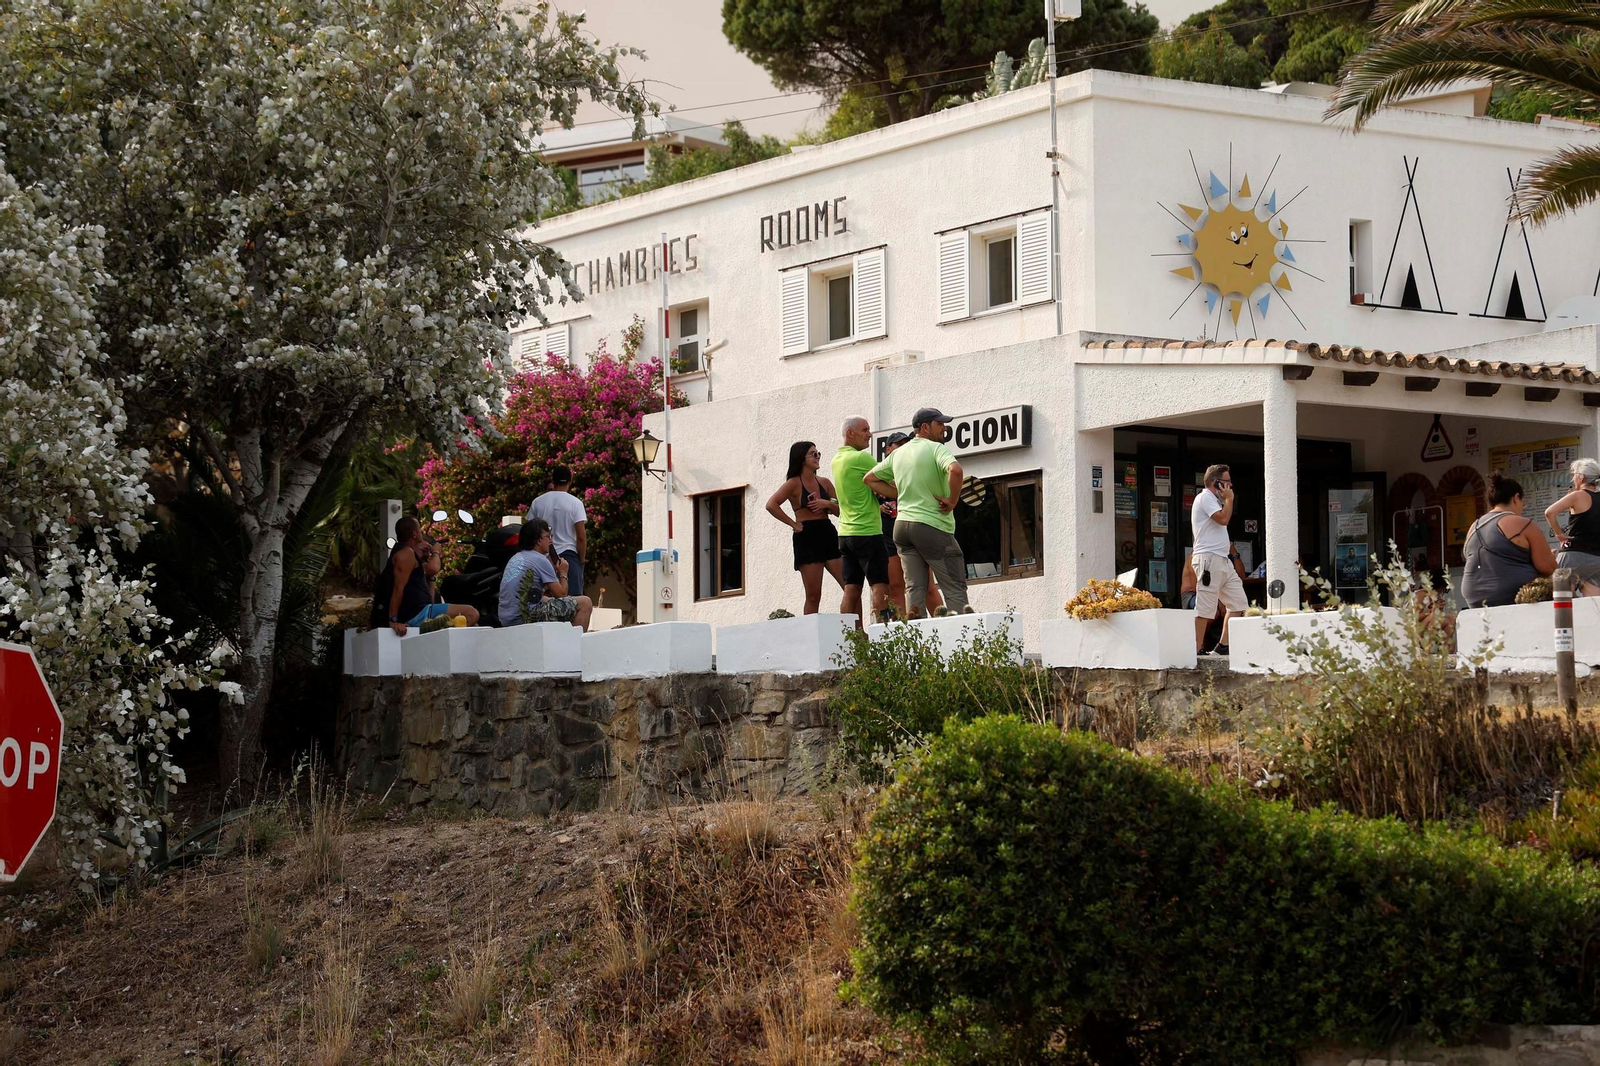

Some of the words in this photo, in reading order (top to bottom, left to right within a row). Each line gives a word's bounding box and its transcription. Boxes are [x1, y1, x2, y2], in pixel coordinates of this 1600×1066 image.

[761, 195, 848, 253] ROOMS
[574, 233, 698, 296] CHAMBRES
[877, 412, 1018, 462] RCION
